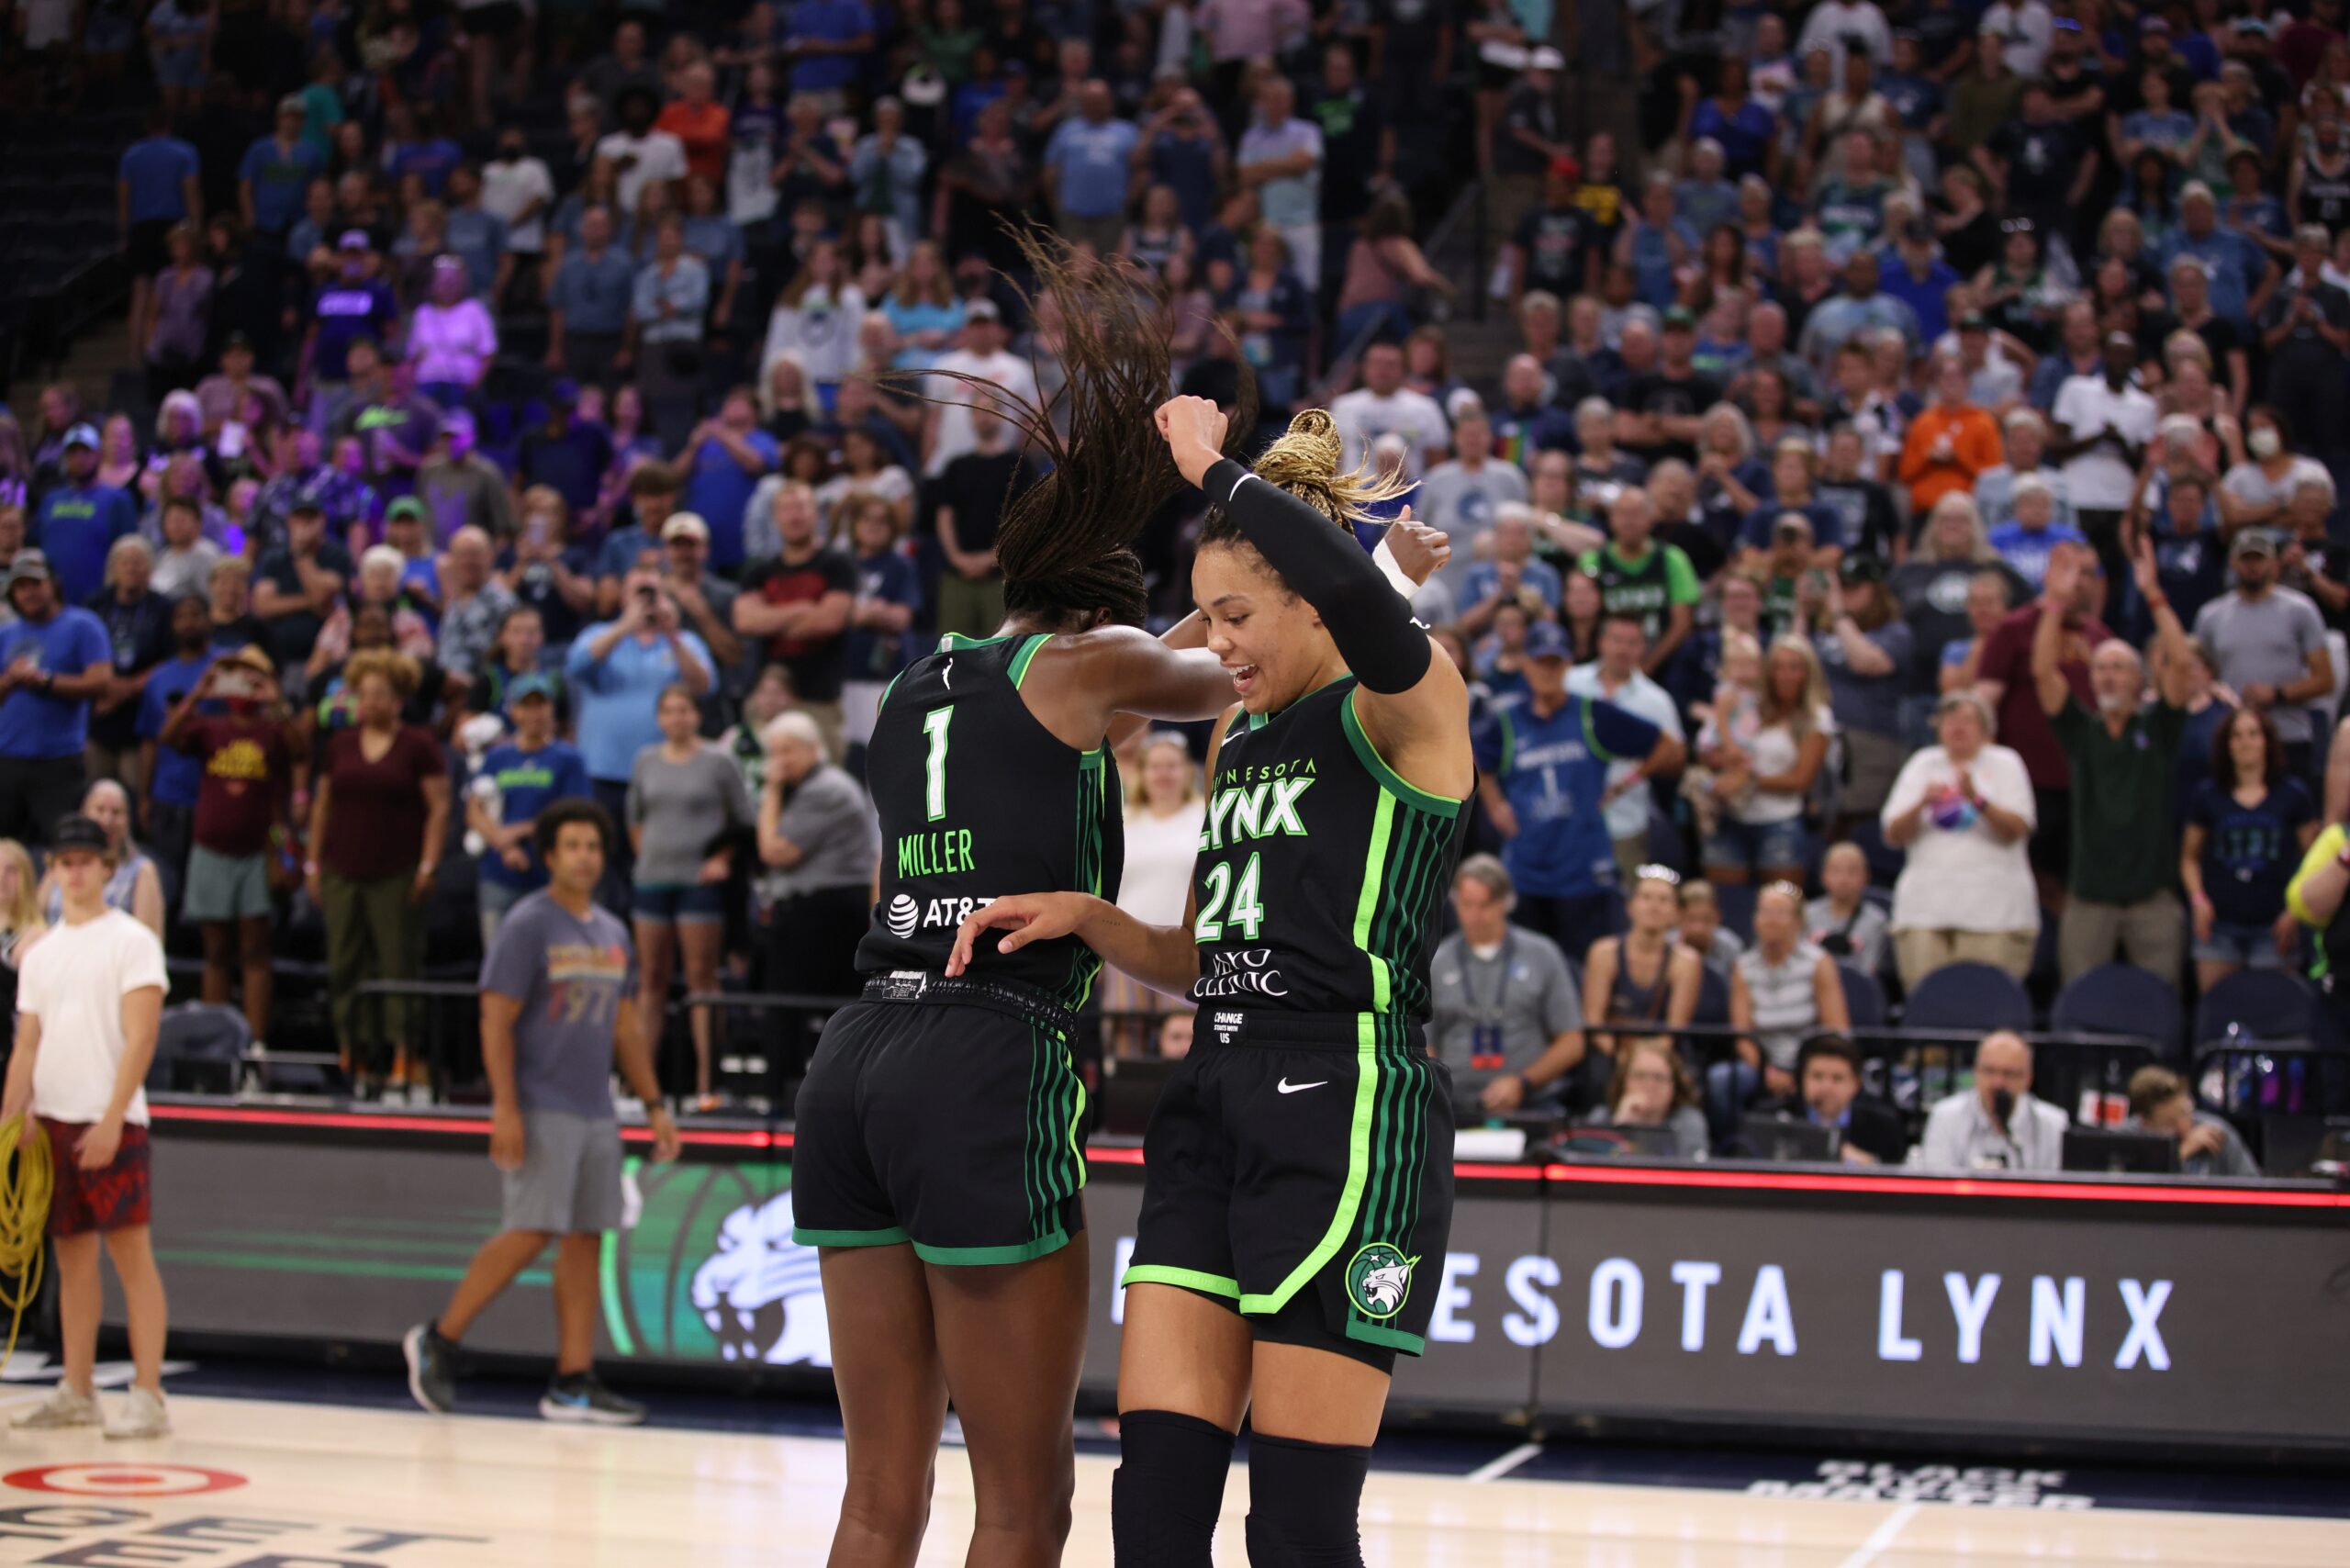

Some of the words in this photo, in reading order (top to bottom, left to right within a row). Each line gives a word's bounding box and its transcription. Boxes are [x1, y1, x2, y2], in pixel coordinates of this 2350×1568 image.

[923, 704, 954, 822] 1
[1212, 757, 1316, 790] NESOTA
[899, 829, 976, 879] MILLER
[1194, 851, 1264, 944] 24
[1214, 1012, 1243, 1025] CHANGE
[1219, 1033, 1230, 1044] US
[1877, 1270, 2173, 1372] LYNX
